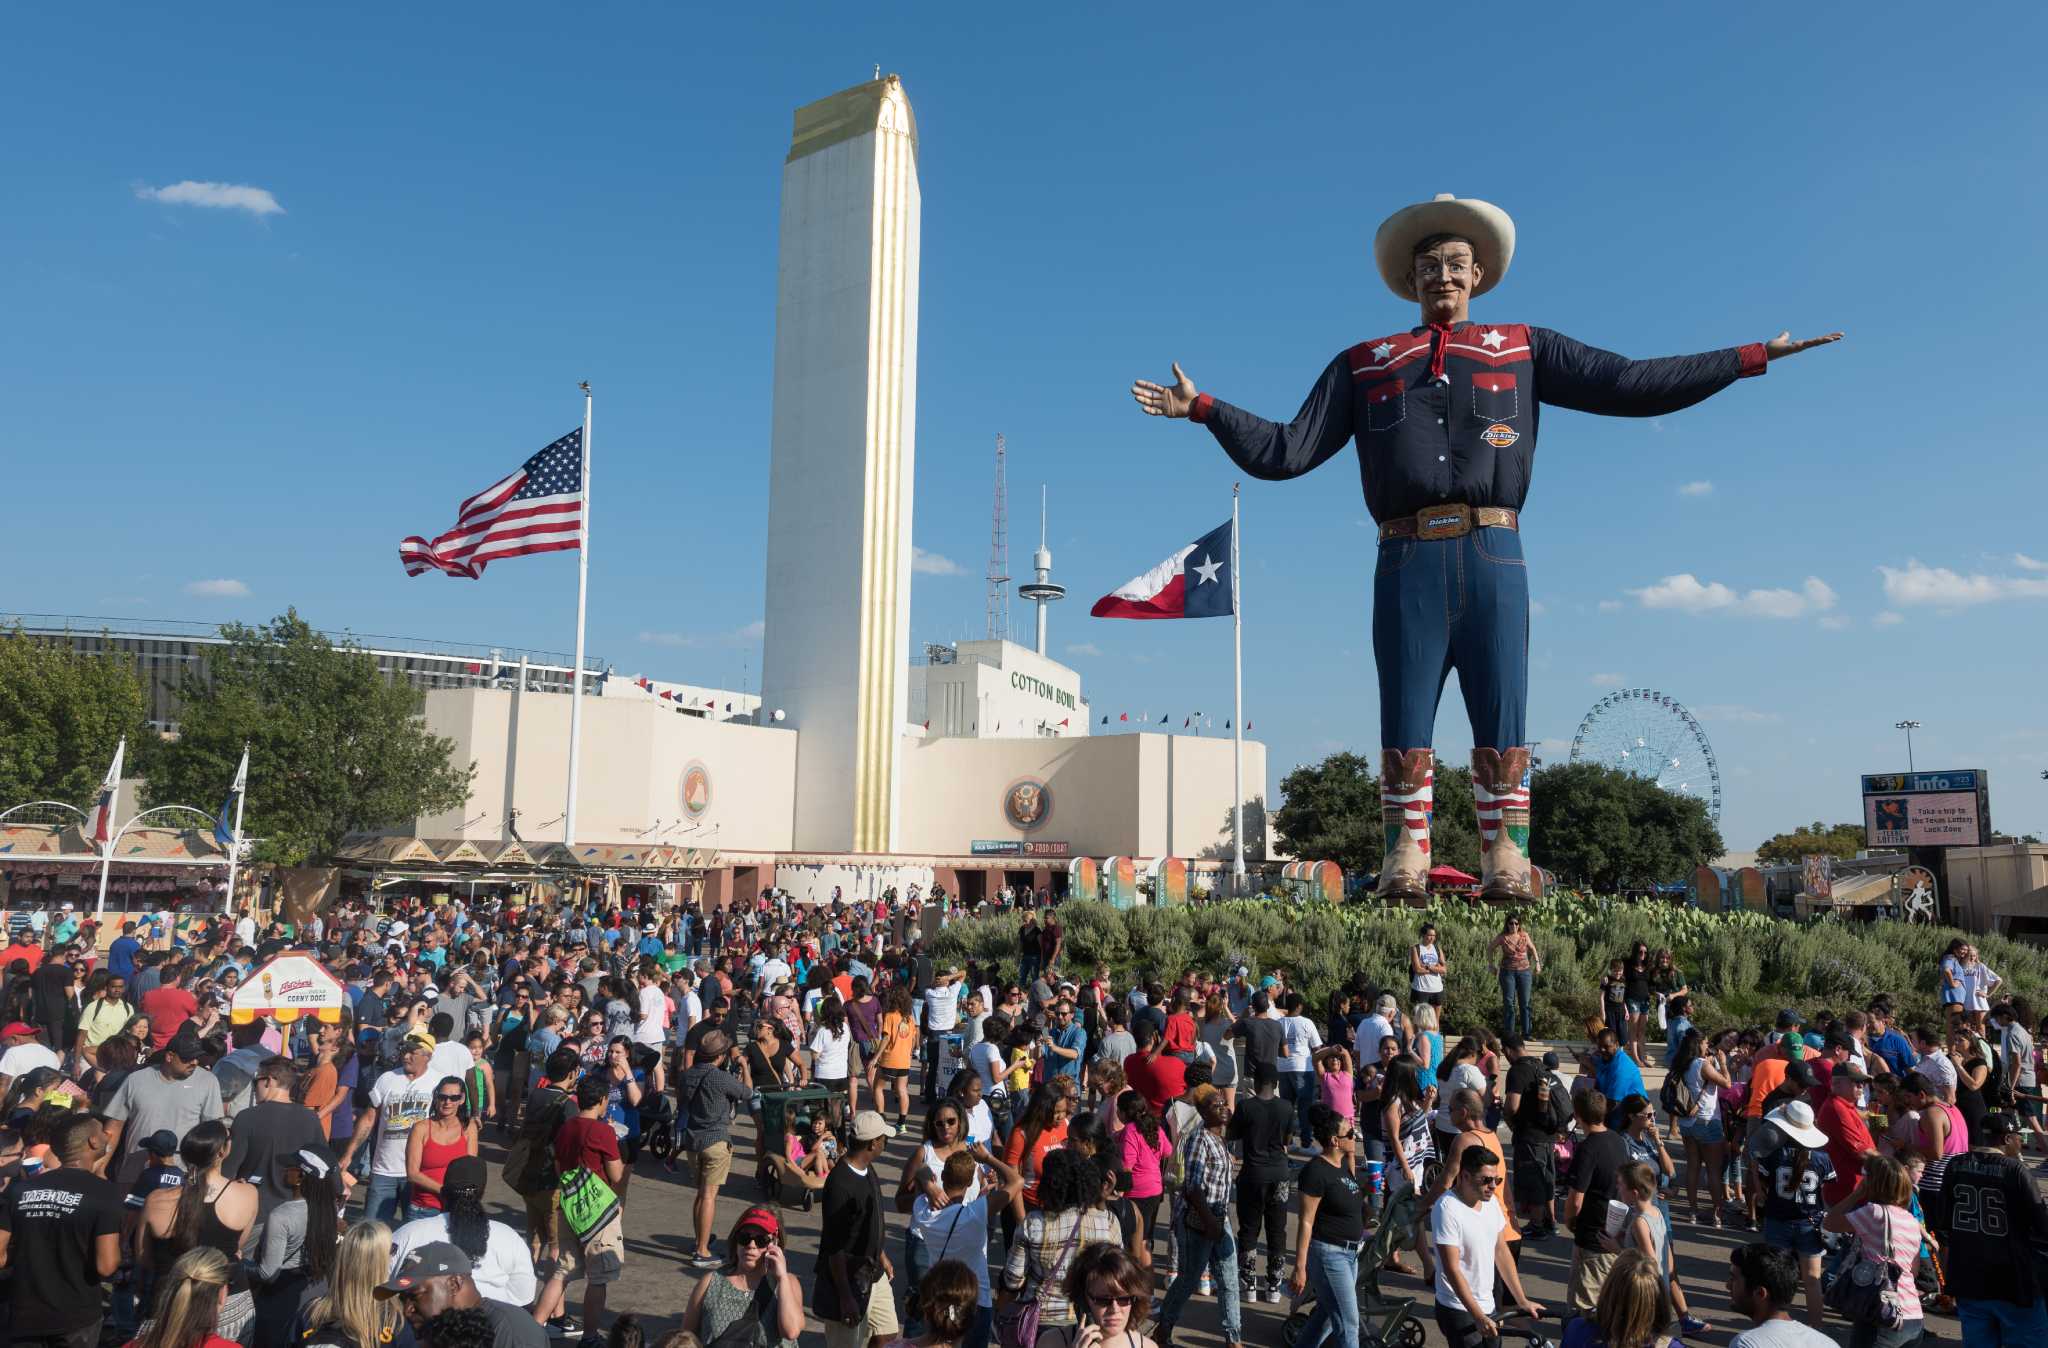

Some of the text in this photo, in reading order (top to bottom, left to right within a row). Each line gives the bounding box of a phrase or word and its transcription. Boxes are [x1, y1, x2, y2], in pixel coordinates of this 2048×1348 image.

[1486, 431, 1517, 440] Dickies
[1428, 517, 1459, 526] Dickies
[1011, 671, 1076, 712] COTTON BOWL
[1914, 775, 1950, 791] info
[1944, 808, 1955, 816] trip
[1948, 816, 1973, 825] Lottery
[1943, 825, 1962, 833] Zone
[1034, 843, 1067, 853] FOOD COURT
[1952, 1184, 2009, 1237] 26
